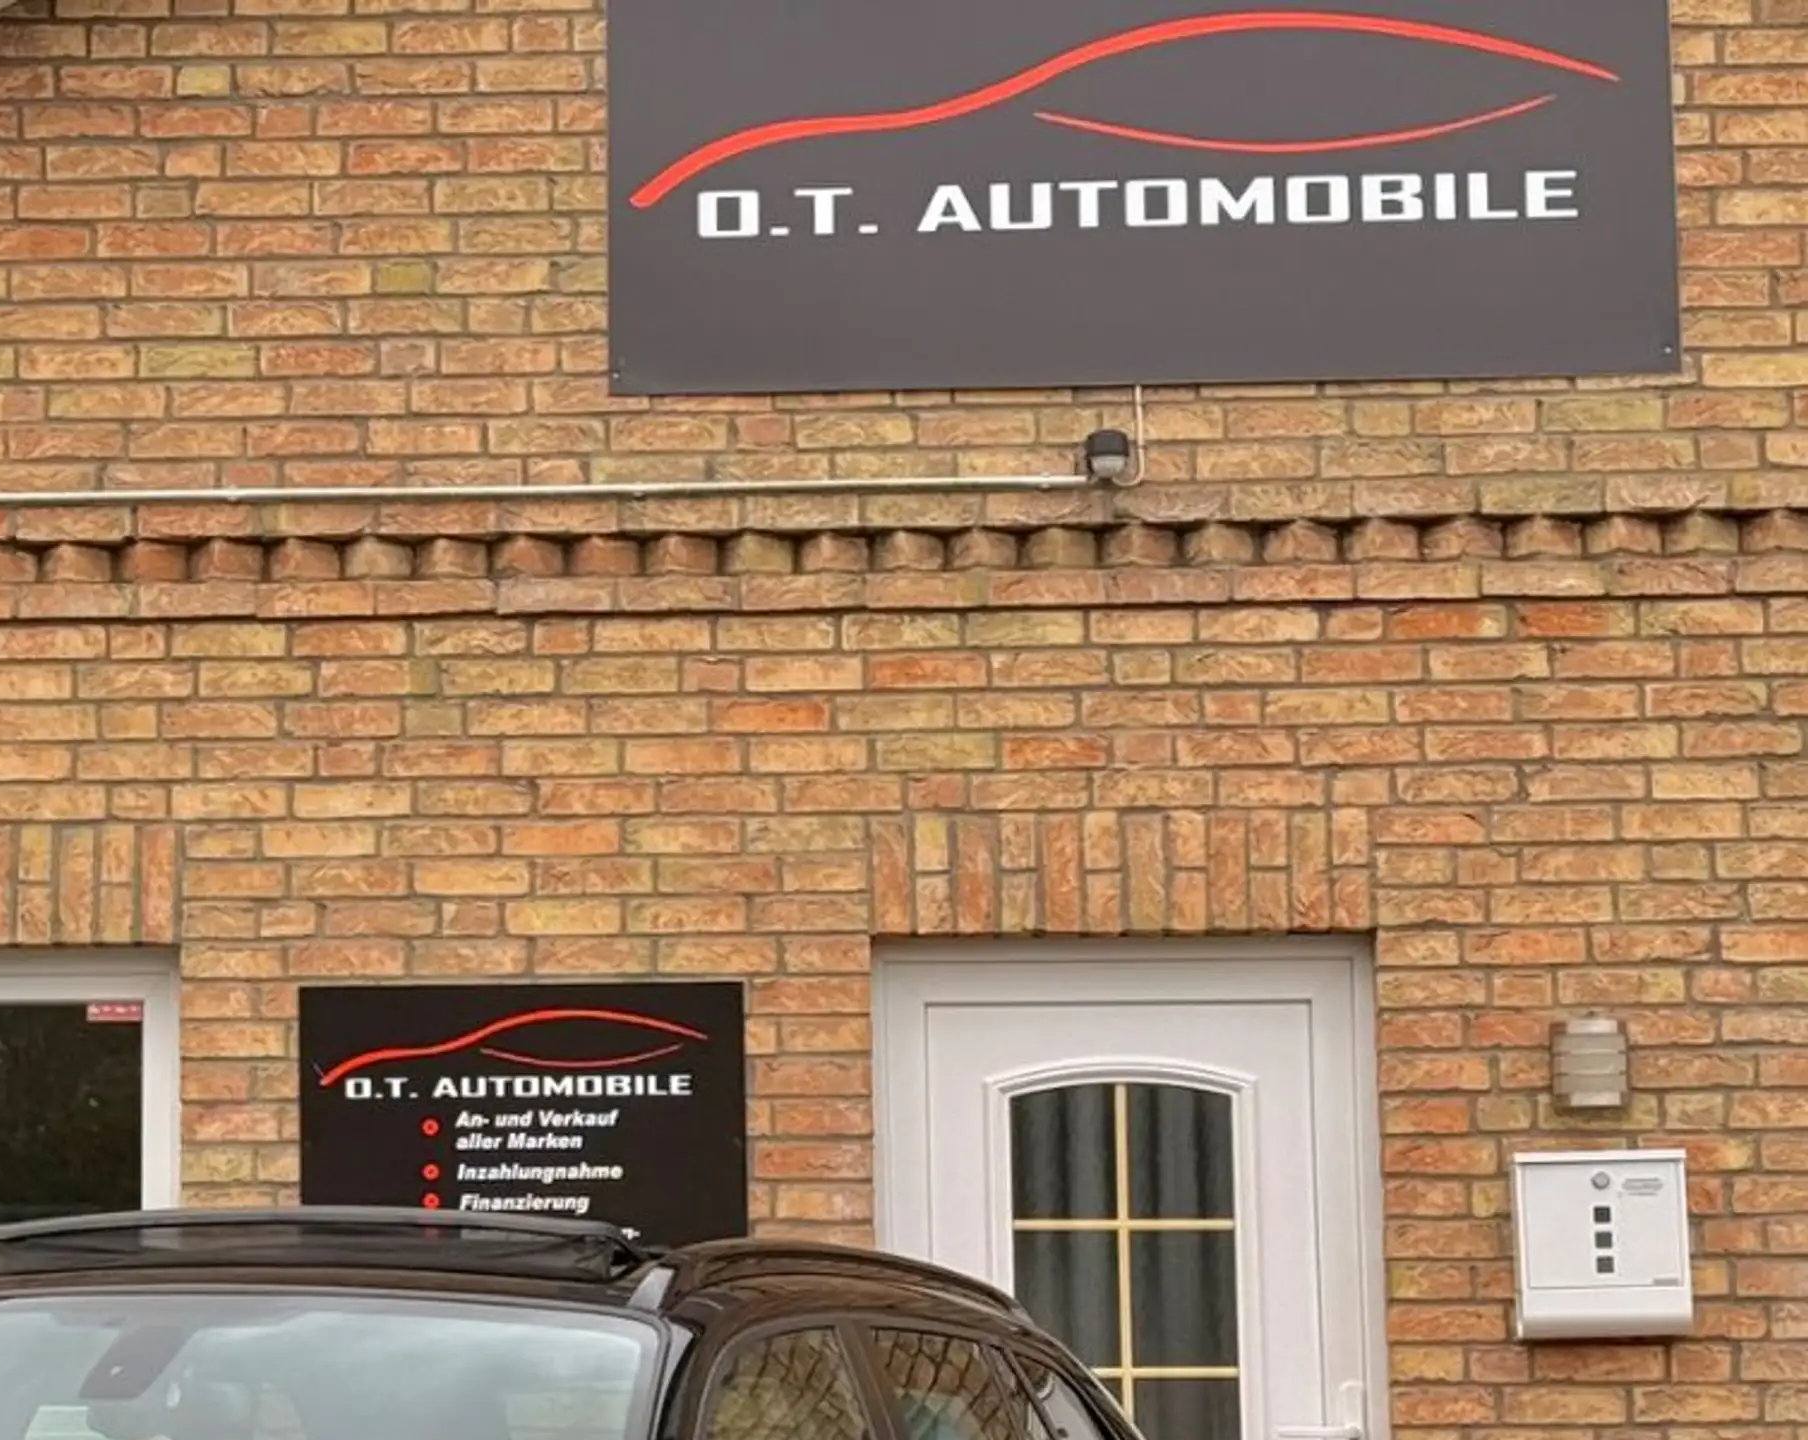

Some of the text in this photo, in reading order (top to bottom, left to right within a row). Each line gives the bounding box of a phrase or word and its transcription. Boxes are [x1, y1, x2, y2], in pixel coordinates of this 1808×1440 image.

[698, 169, 1579, 238] O.T. AUTOMOBILE
[344, 1074, 692, 1099] O.T. AUTOMOBILE
[455, 1109, 620, 1128] An- und Verkauf
[456, 1133, 583, 1150] aller Marken
[457, 1162, 624, 1184] Inzahlungnahme
[459, 1193, 591, 1215] Finanzierung
